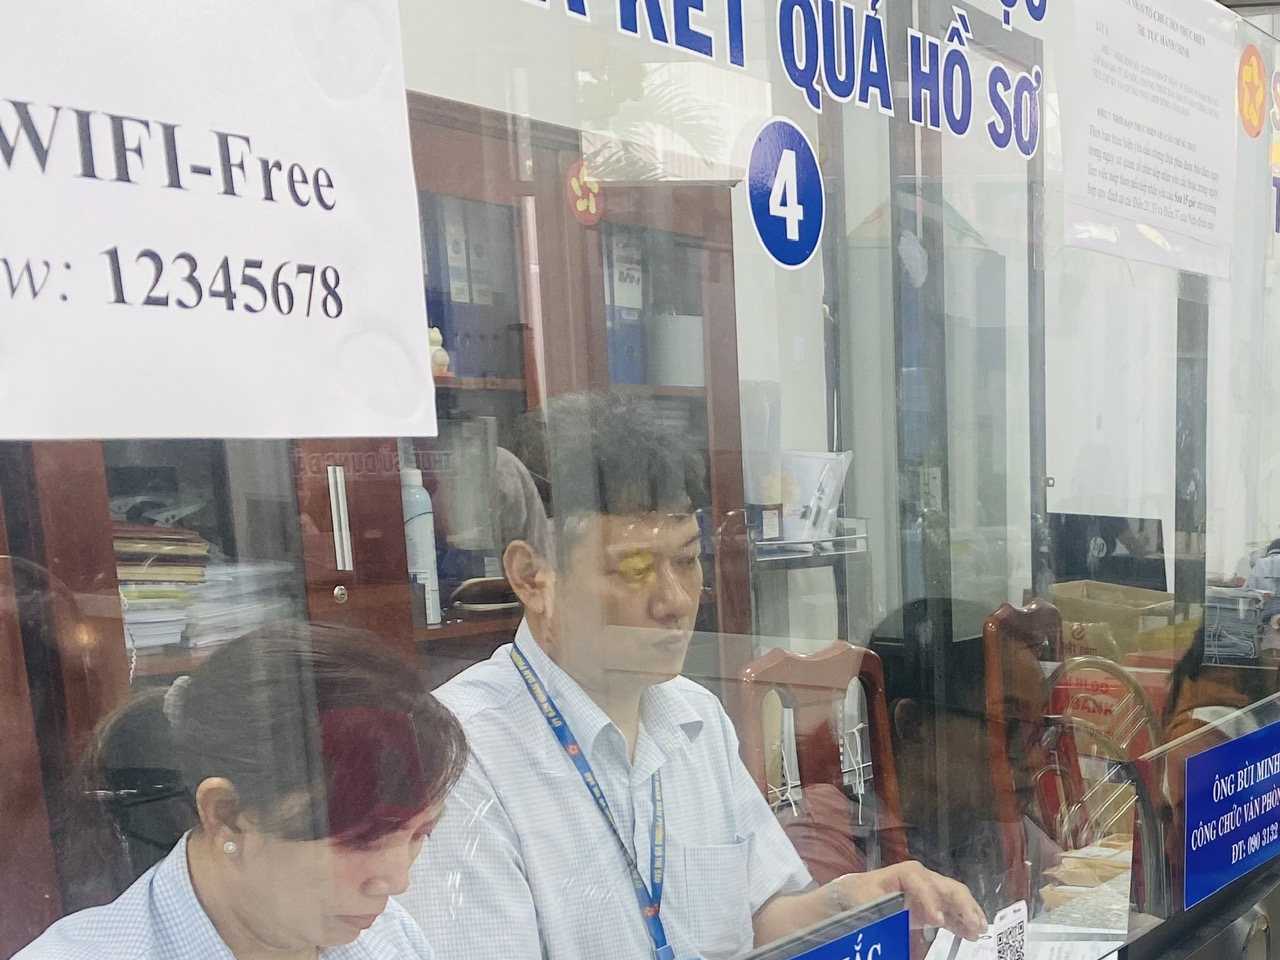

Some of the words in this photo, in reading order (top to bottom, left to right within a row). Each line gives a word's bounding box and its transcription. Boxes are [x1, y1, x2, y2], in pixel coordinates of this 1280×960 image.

[909, 13, 973, 136] HỒ
[987, 66, 1042, 156] SƠ
[0, 98, 336, 211] WIFI-Free
[769, 149, 804, 241] 4
[100, 246, 343, 319] 12345678
[1213, 773, 1235, 803] ÔNG
[1236, 761, 1255, 793] BÙI
[1256, 753, 1280, 783] MINH
[1191, 820, 1217, 851] CÔNG
[1218, 804, 1243, 837] CHỨC
[1244, 794, 1260, 823] VĂN
[1231, 843, 1246, 864] ĐT:
